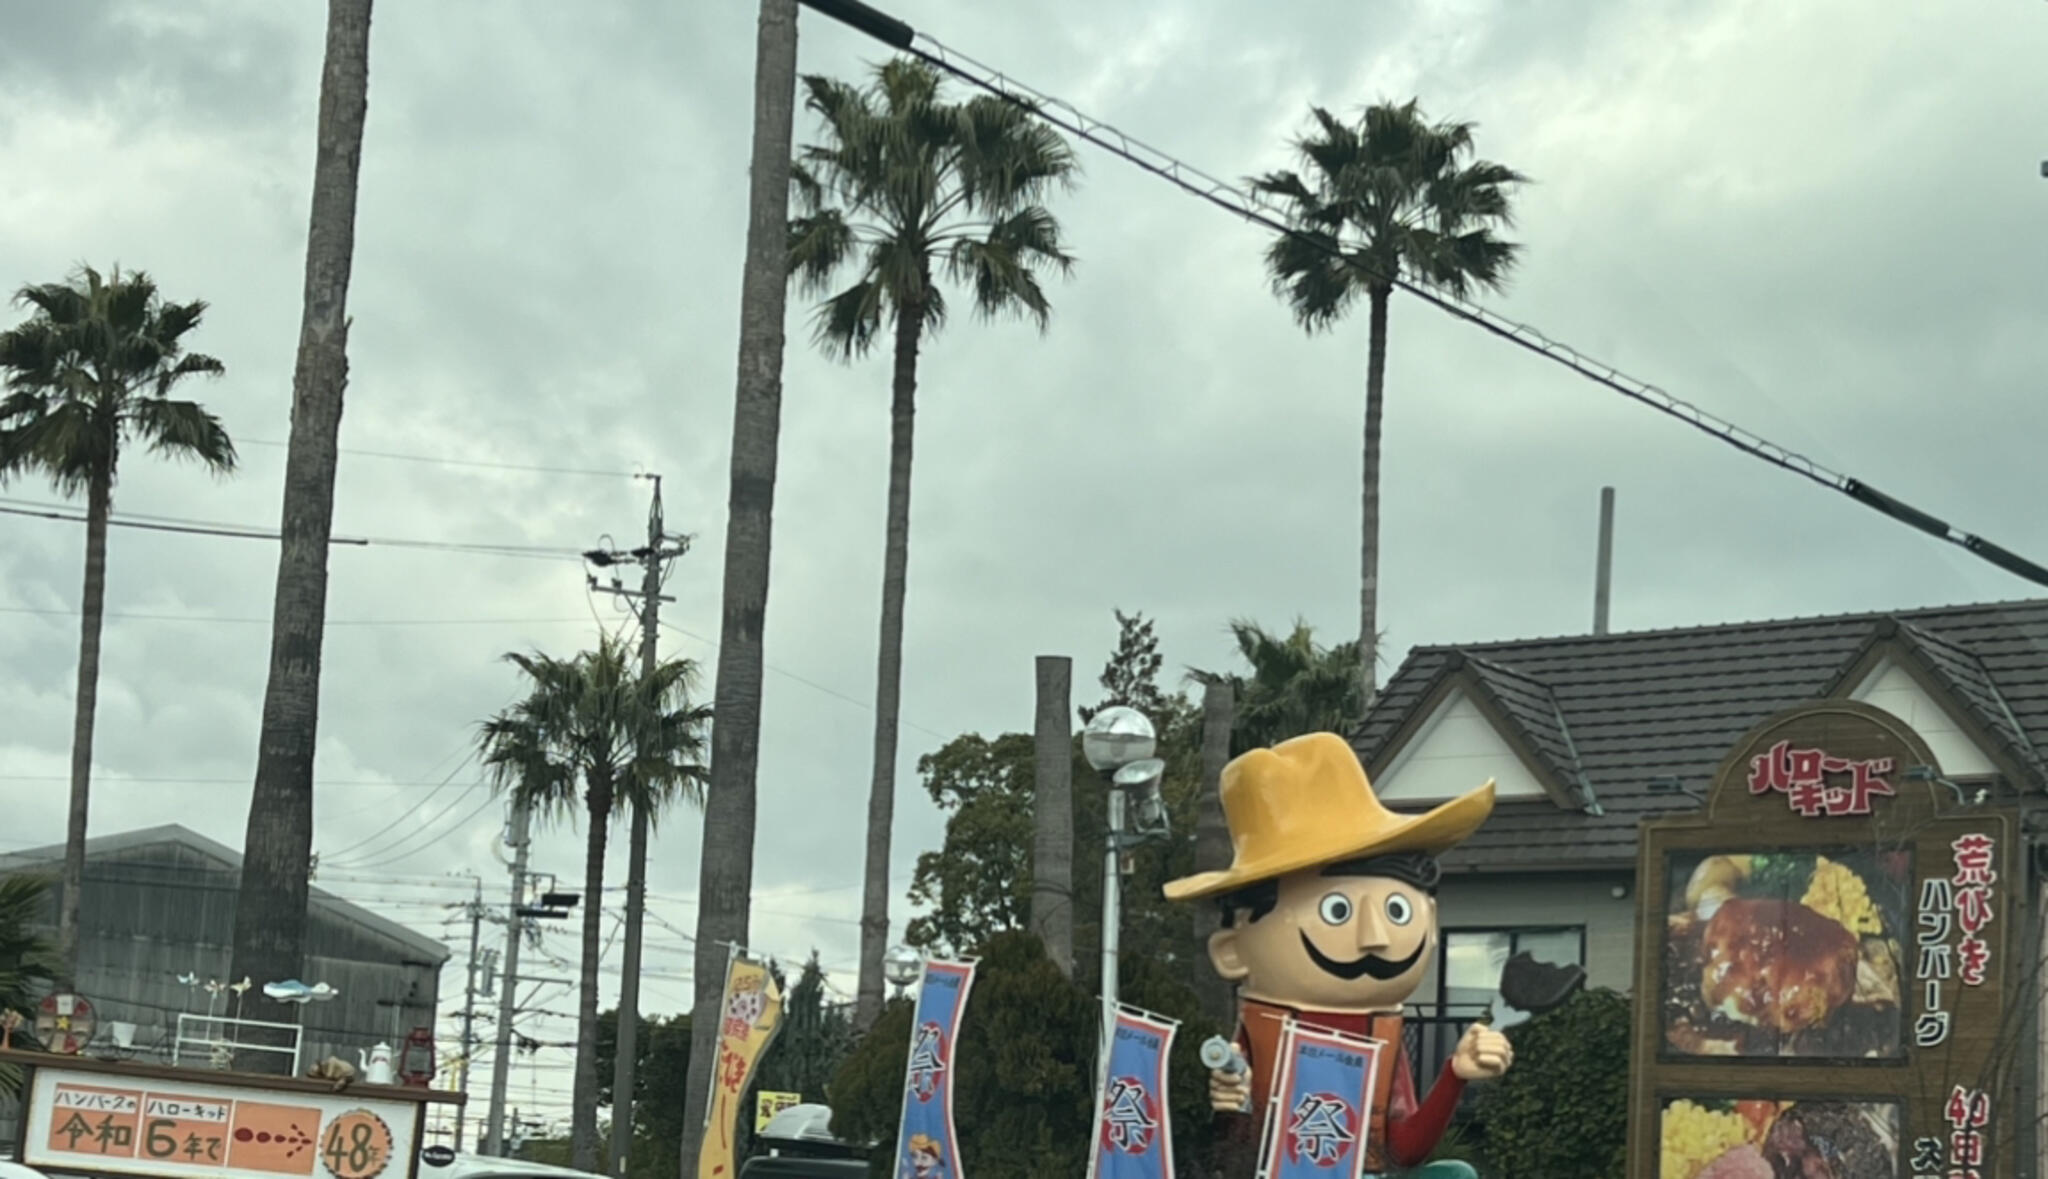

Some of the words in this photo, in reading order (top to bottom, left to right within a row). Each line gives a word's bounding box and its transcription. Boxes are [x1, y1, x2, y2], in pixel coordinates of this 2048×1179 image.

[1951, 834, 1997, 985] 荒びき
[1915, 878, 1952, 1046] ハンバーグ
[55, 1112, 132, 1153] 令和
[146, 1119, 221, 1161] 6年で
[1103, 1077, 1159, 1152] 祭
[1289, 1092, 1356, 1162] 祭
[1944, 1084, 1991, 1179] 40日
